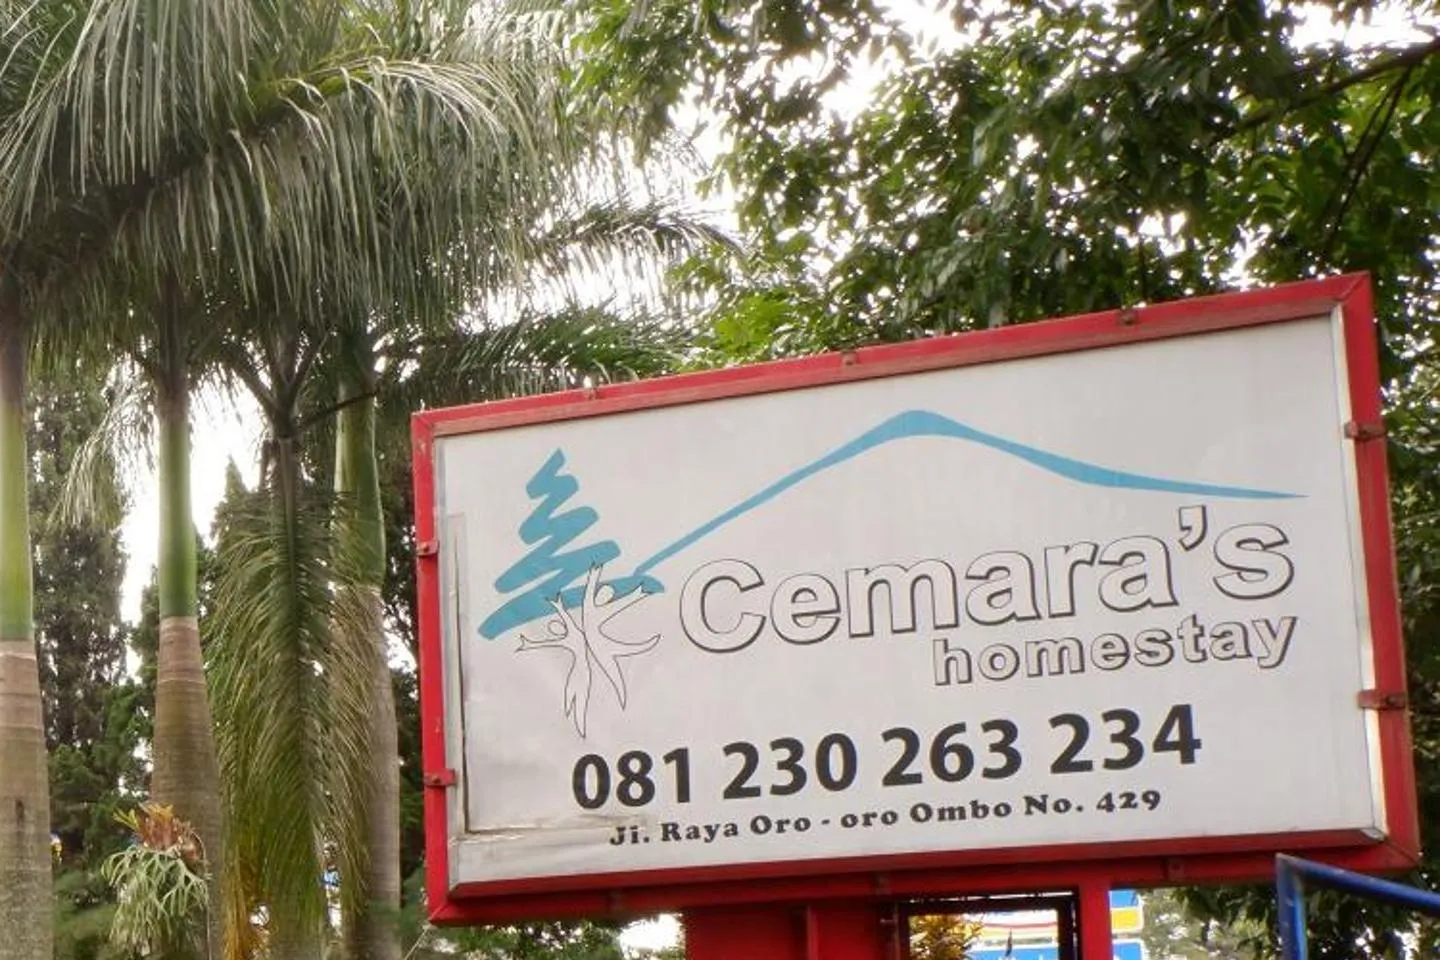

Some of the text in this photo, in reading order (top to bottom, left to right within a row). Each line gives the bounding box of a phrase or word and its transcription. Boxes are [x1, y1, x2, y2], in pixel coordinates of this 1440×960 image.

[679, 505, 1294, 654] Cemara's
[932, 614, 1297, 686] homestay
[572, 703, 1203, 810] 081 230 263 234
[660, 820, 739, 844] Raya
[750, 814, 812, 835] Oro
[840, 808, 899, 829] oro
[910, 798, 1013, 824] Ombo
[1023, 793, 1084, 817] No.
[1096, 790, 1162, 813] 429
